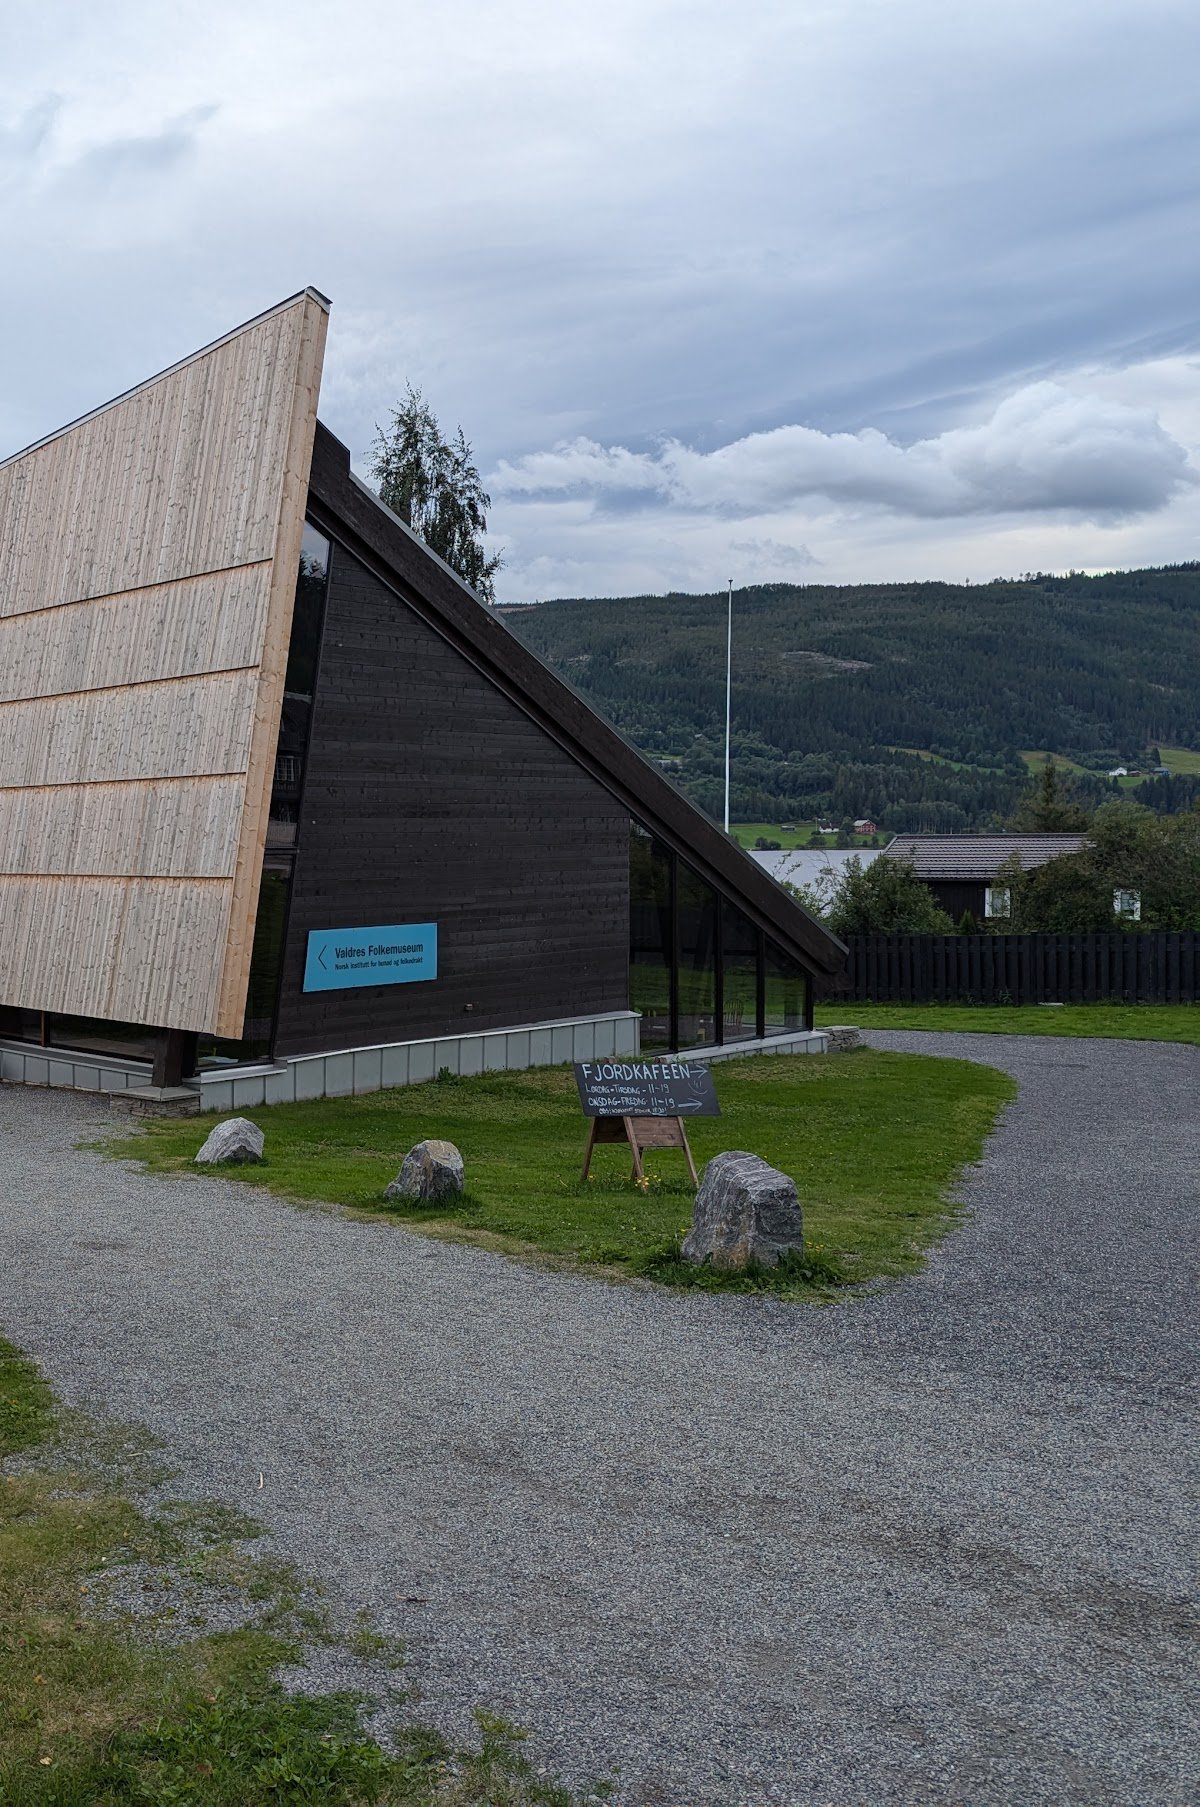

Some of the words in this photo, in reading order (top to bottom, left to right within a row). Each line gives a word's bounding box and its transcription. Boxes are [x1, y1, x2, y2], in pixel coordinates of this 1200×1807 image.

[335, 947, 366, 958] Valdres
[368, 944, 423, 956] Folkemuseum
[582, 1064, 690, 1081] FJORDKAFEEN
